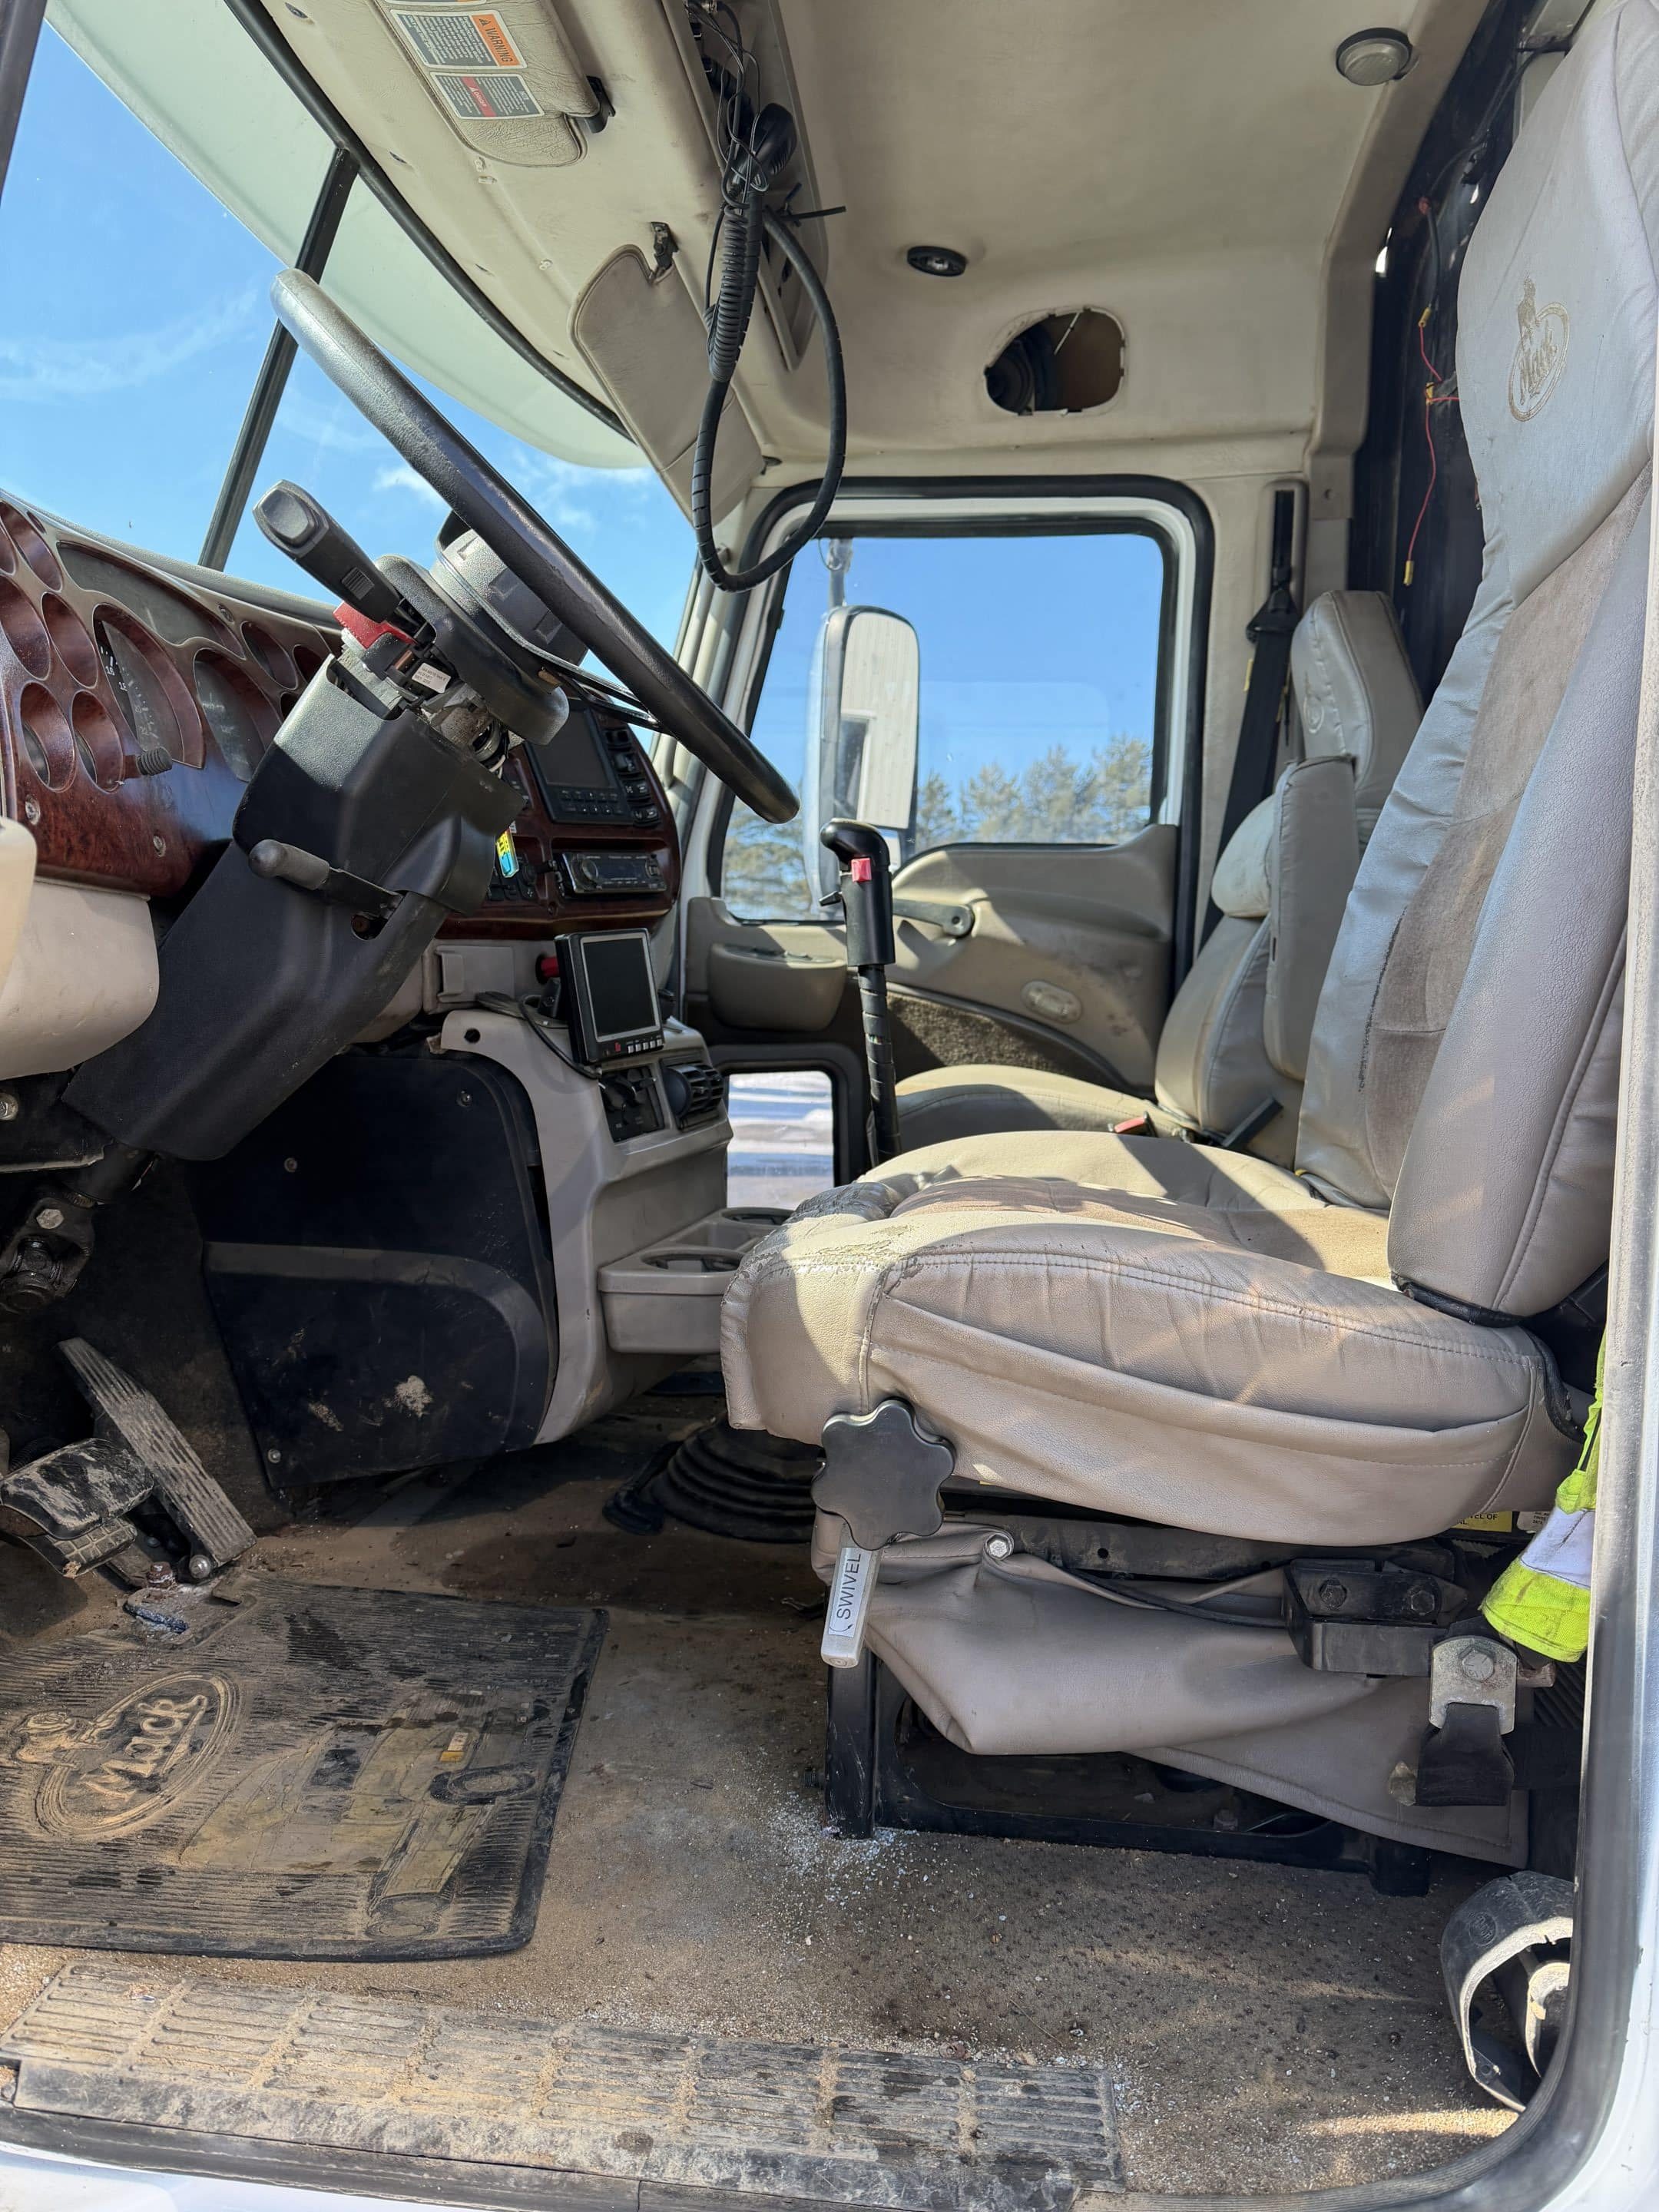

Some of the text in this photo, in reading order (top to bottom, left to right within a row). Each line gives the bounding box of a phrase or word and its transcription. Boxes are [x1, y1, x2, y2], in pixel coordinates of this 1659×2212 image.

[485, 27, 513, 62] WARNING
[836, 1553, 862, 1621] SWIVEL
[78, 1694, 207, 1803] Mack
